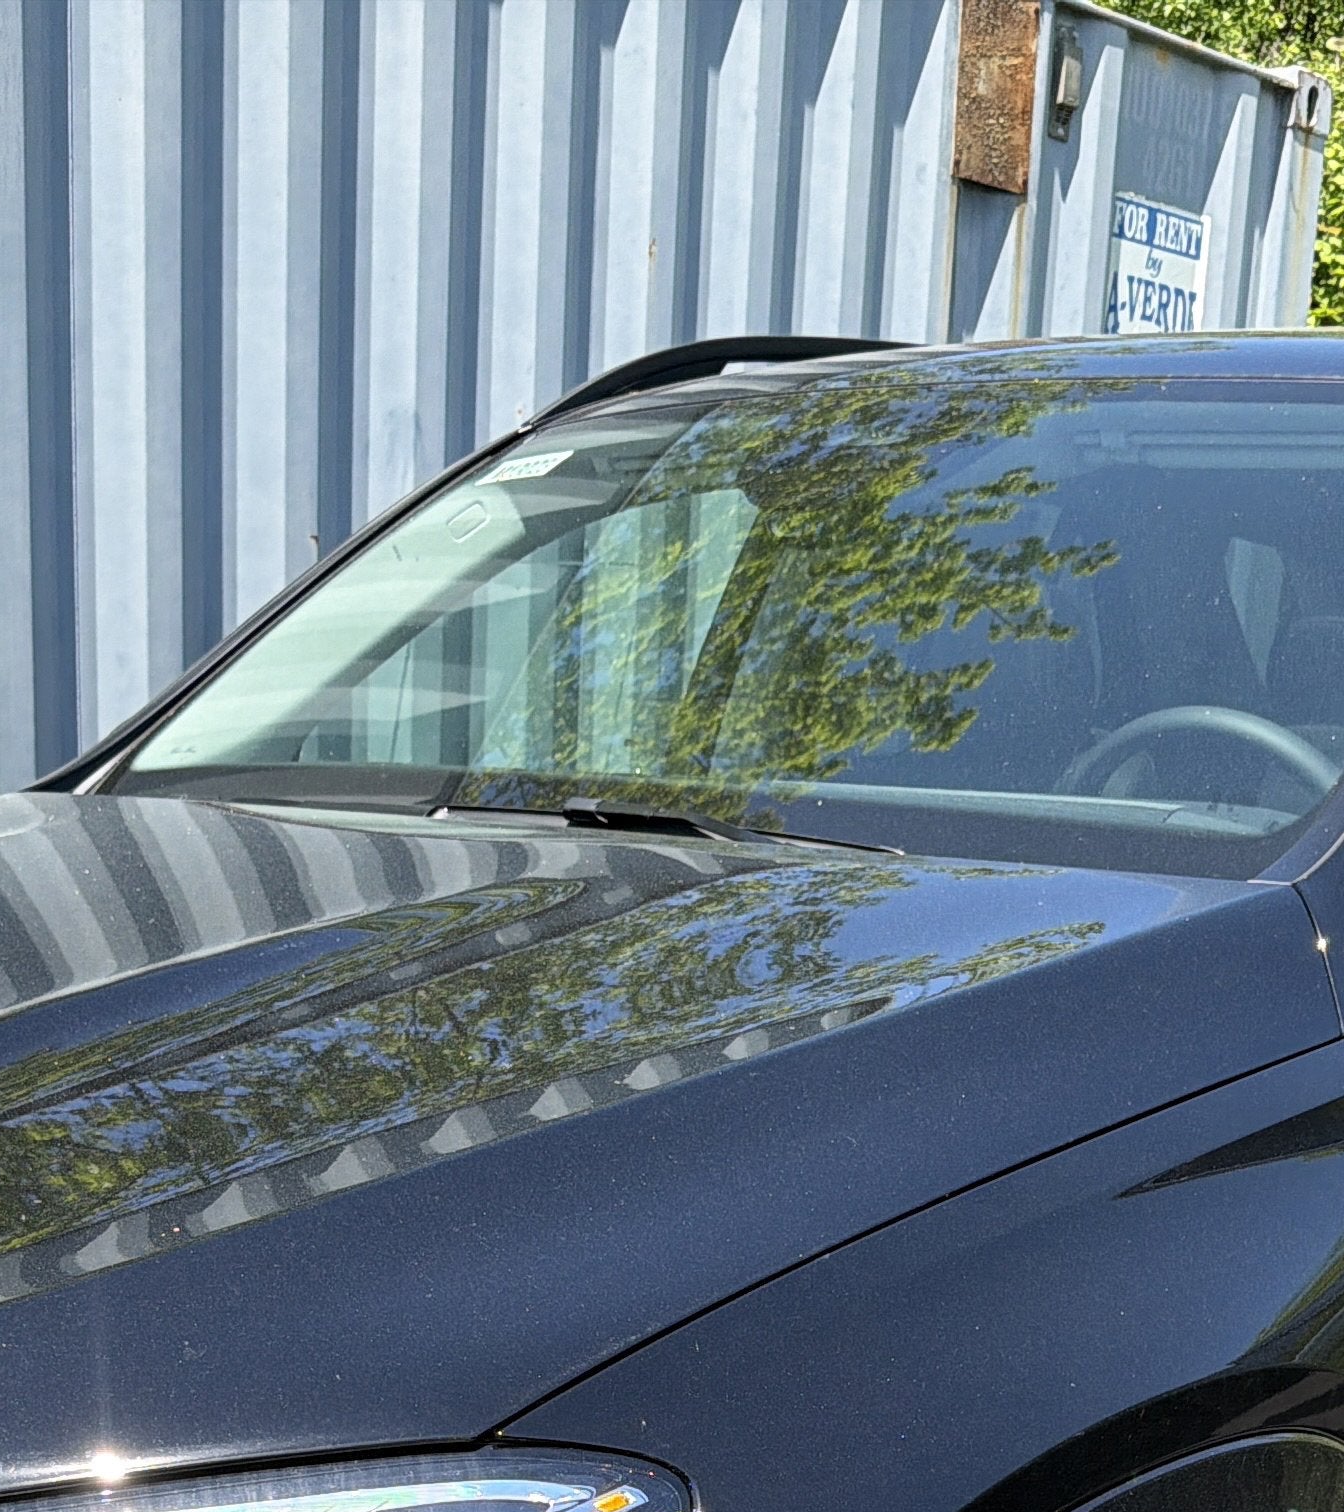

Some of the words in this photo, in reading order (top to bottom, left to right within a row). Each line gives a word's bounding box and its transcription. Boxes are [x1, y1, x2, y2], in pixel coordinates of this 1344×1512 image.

[1113, 200, 1149, 242] FOR
[1153, 212, 1202, 256] RENT
[1145, 249, 1164, 279] by
